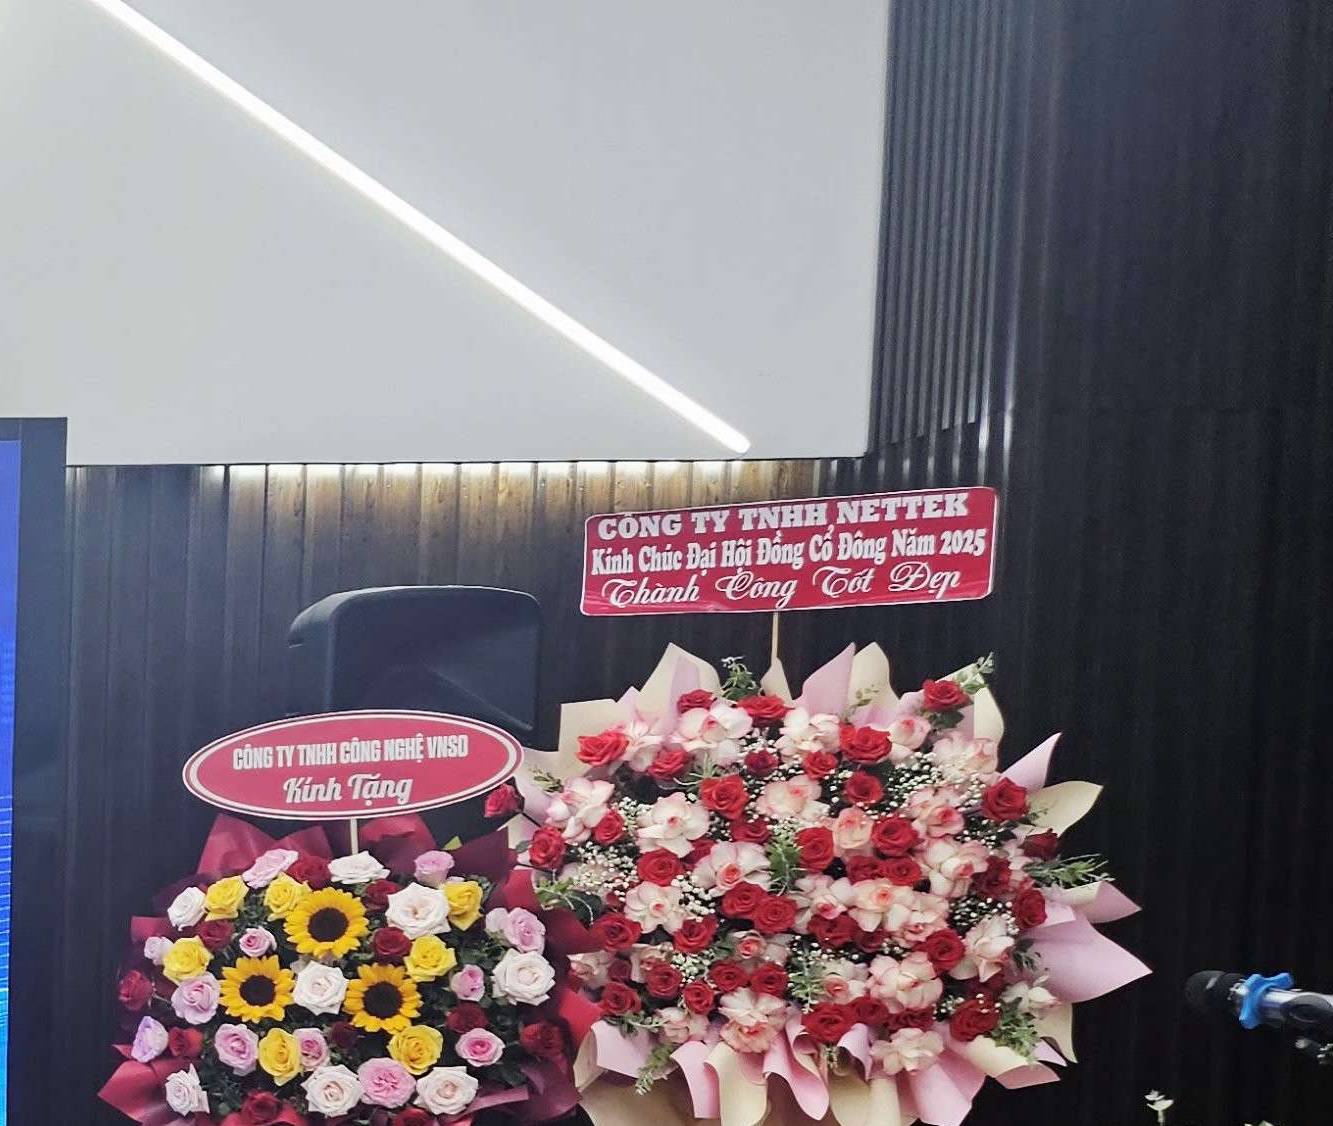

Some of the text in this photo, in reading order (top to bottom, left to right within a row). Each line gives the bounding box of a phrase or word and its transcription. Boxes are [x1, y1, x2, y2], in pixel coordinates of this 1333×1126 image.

[598, 493, 969, 541] CÔNG TY TNHH NETTEK
[591, 524, 987, 577] Kính Chúc Đại Hội Đồng Cổ Đông Năm 2025
[601, 561, 960, 609] Thành Công Tốt Đẹp
[233, 744, 273, 770] CÔNG
[276, 746, 296, 767] TY
[297, 743, 338, 767] TNHH
[339, 737, 381, 764] CÔNG
[383, 733, 424, 763] NGHỆ
[283, 773, 413, 806] Kính Tặng
